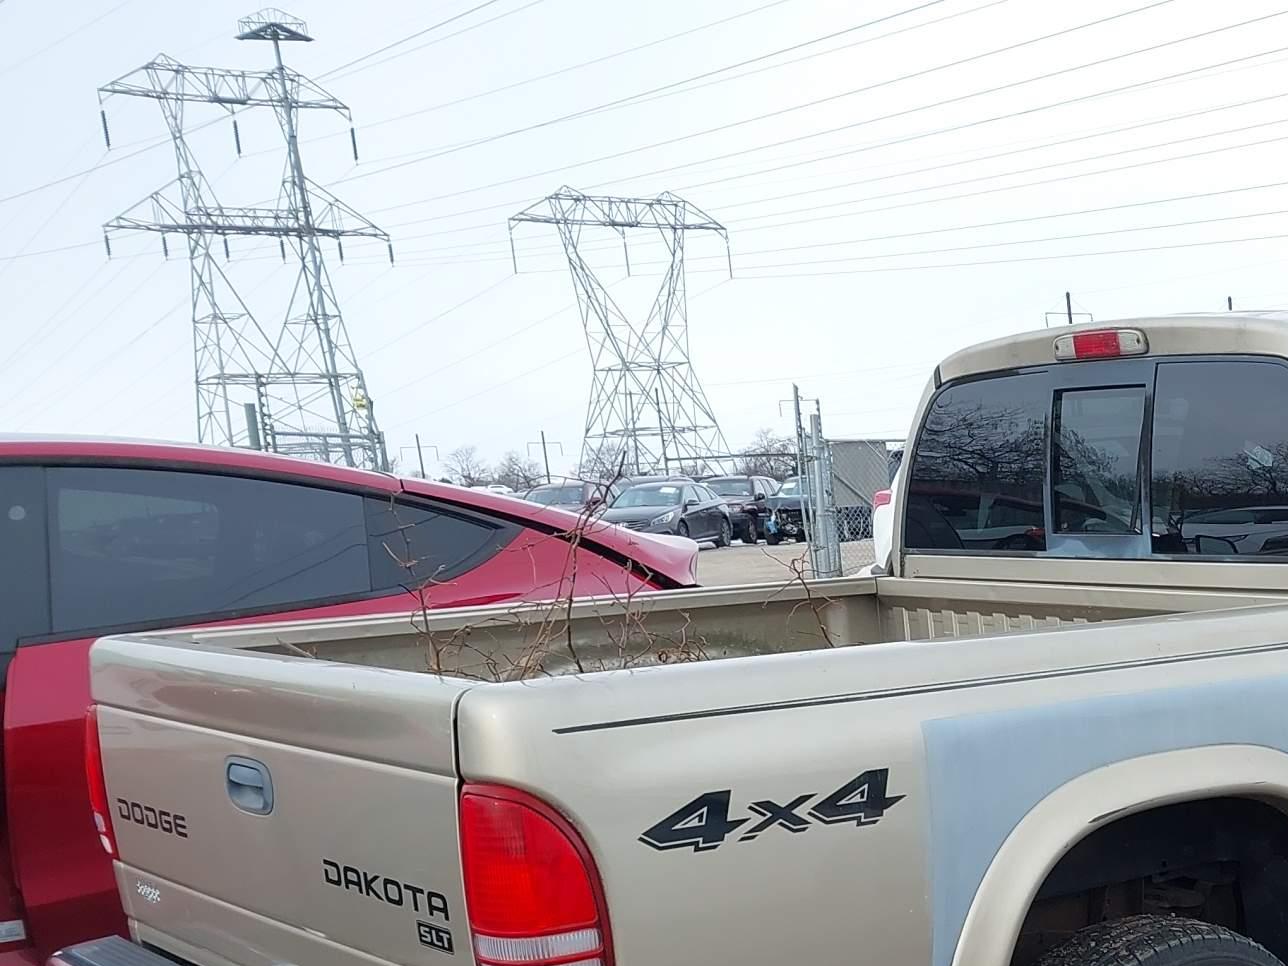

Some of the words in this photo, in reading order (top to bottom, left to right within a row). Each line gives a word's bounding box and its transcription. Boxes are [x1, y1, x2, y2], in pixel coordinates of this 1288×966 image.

[117, 798, 188, 838] DODGE
[323, 859, 450, 921] DAKOTA
[418, 924, 452, 950] SLT
